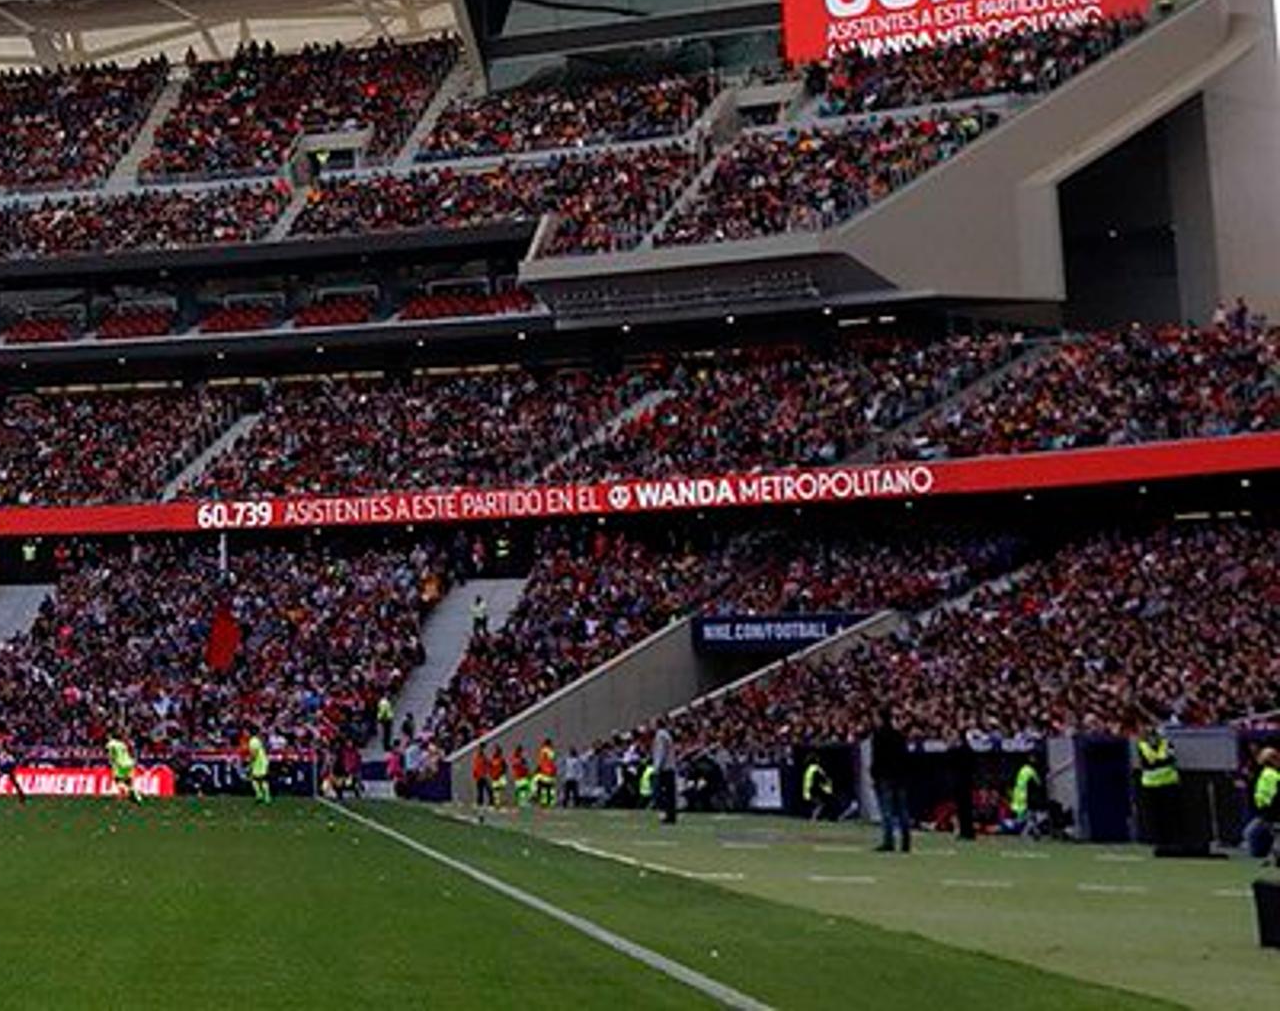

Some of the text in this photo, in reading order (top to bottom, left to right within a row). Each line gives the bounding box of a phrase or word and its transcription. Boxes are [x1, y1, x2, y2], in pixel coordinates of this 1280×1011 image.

[827, 11, 919, 42] ASISTENTES
[920, 9, 933, 30] A
[934, 1, 974, 27] ESTE
[197, 465, 934, 529] 60.739 ASISTENTES A ESTE PARTIDO EN EL WANDA METROPOLITANO
